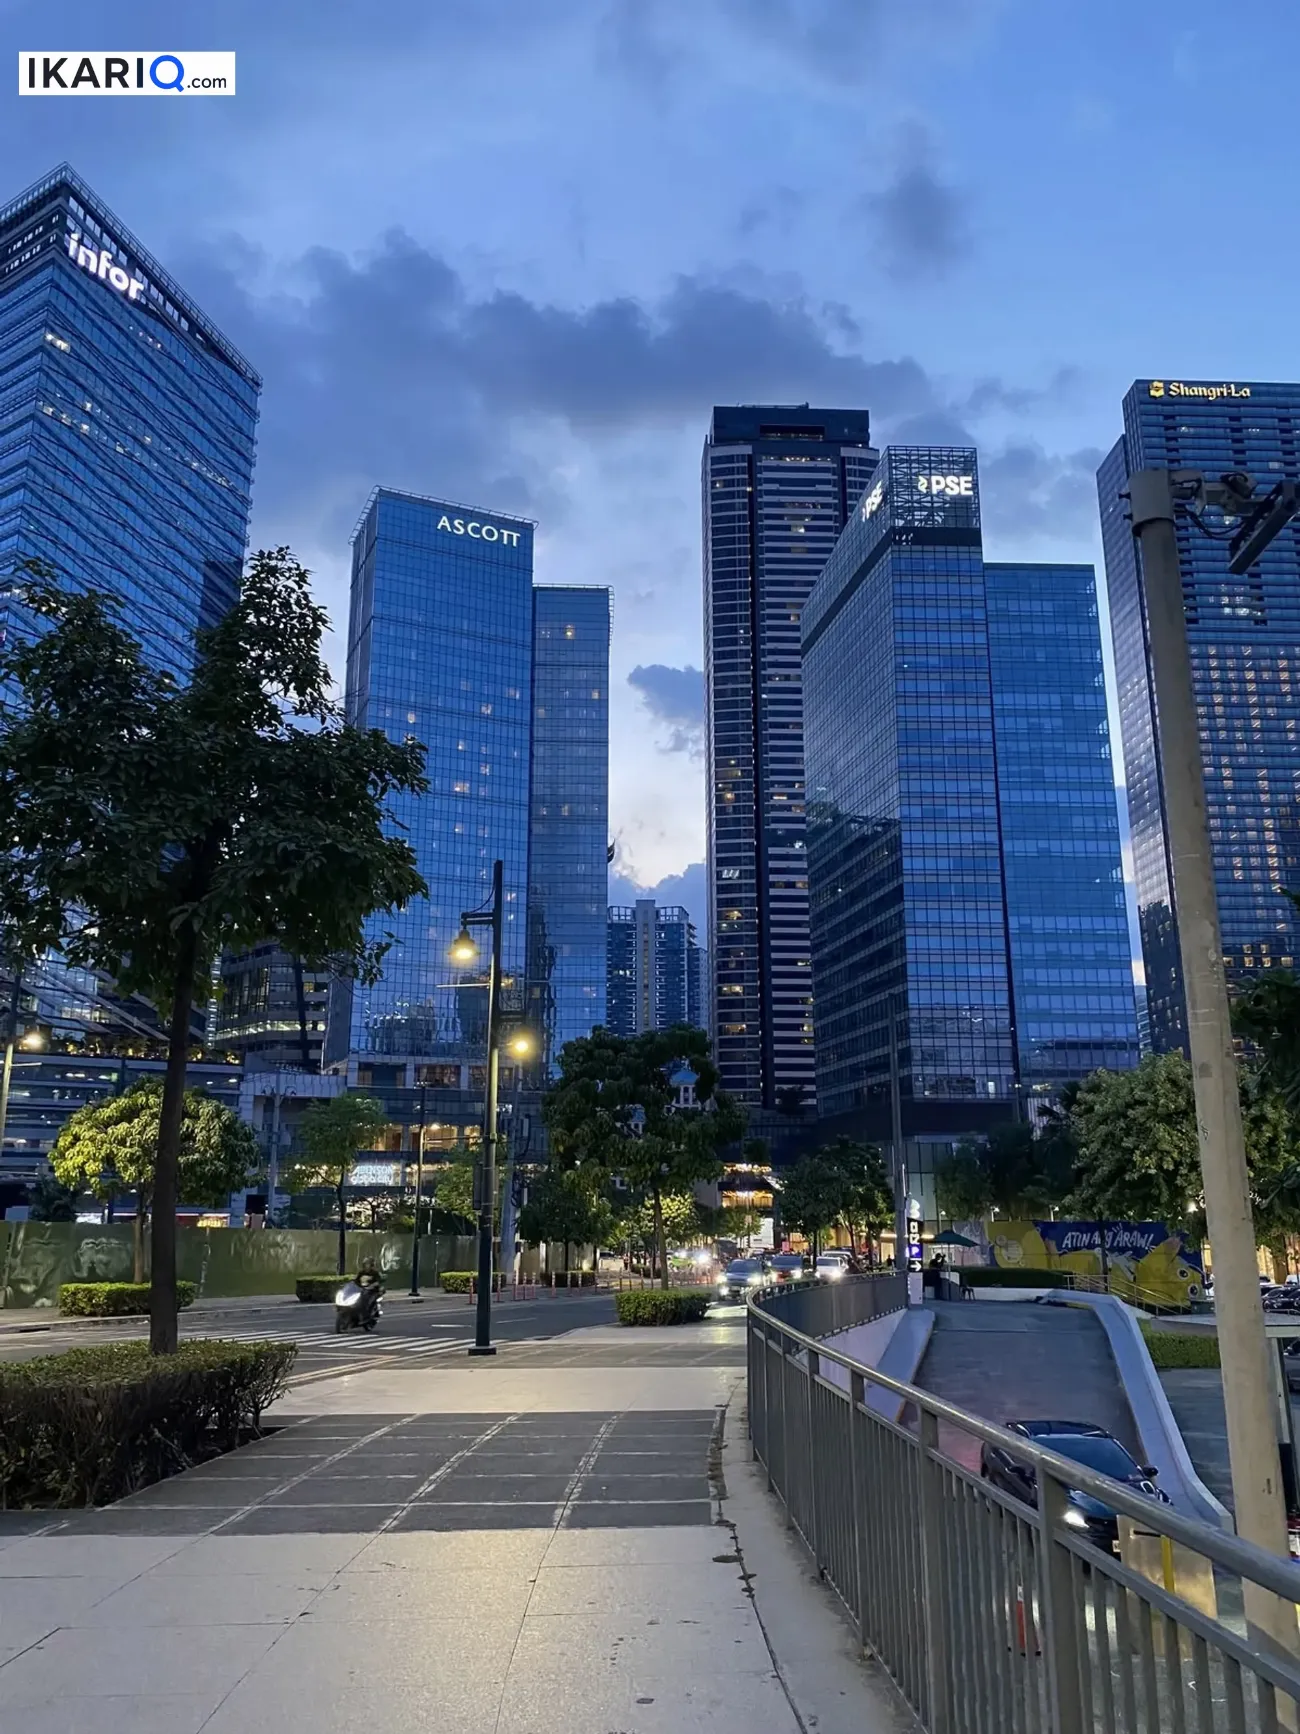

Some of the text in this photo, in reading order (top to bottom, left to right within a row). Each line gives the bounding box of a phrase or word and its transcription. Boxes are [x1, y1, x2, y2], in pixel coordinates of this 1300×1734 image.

[69, 233, 144, 299] infor
[1169, 382, 1250, 400] Shangri-La
[931, 475, 973, 495] PSE
[437, 516, 521, 547] ASCOTT
[1062, 1231, 1091, 1248] ATIN
[1114, 1229, 1155, 1250] ARAW!
